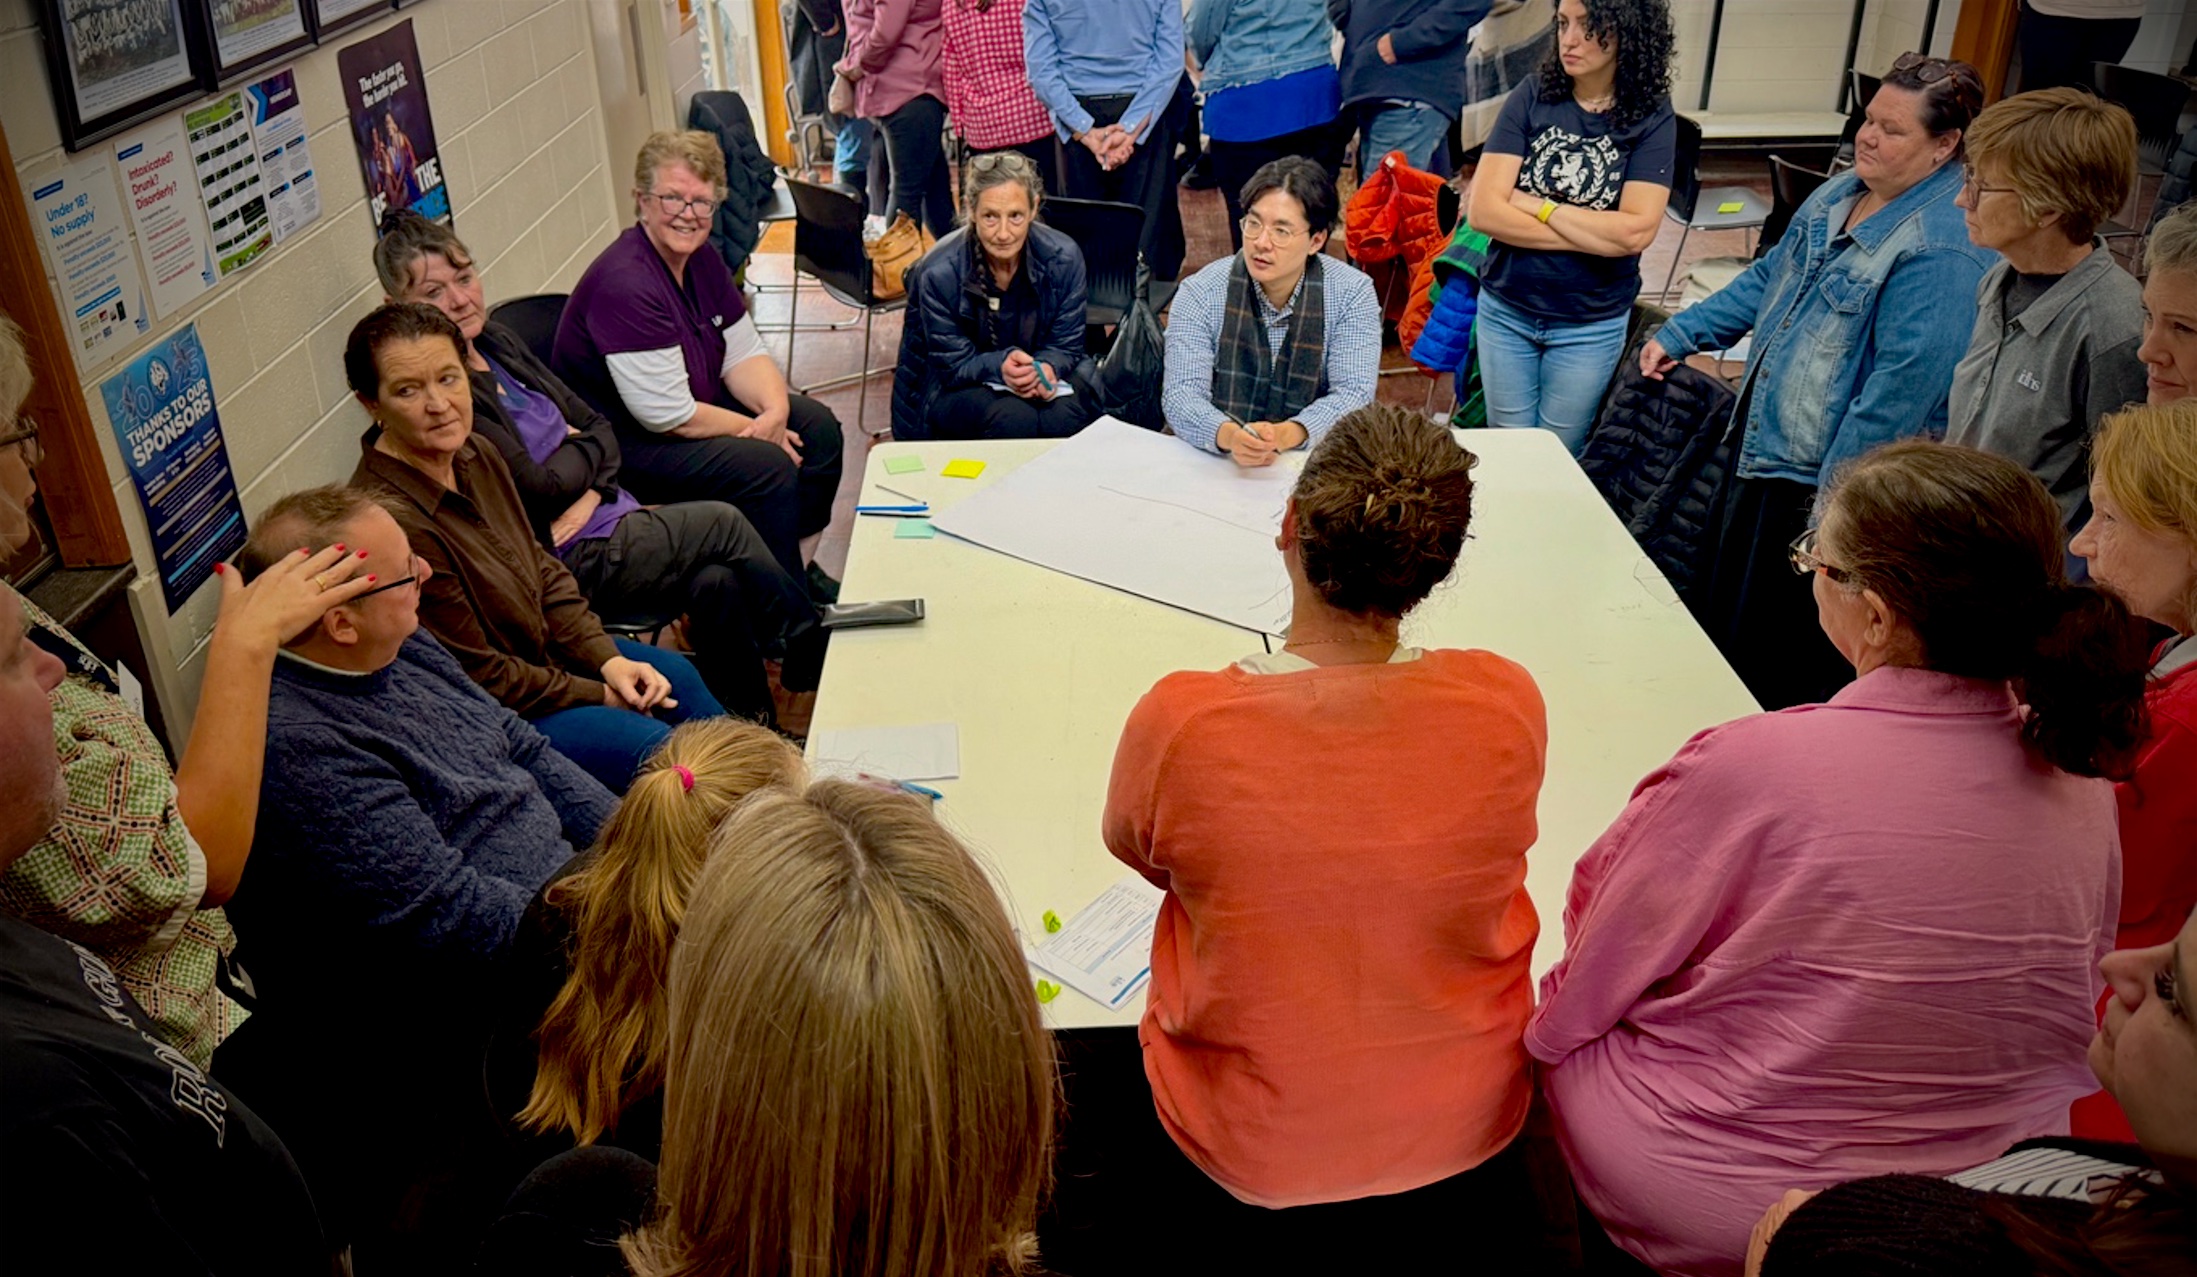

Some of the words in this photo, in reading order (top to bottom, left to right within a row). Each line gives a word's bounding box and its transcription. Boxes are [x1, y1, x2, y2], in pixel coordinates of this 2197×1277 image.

[358, 76, 372, 92] The
[1530, 125, 1619, 166] HILFER
[128, 151, 173, 181] Intoxicated?
[414, 157, 442, 193] THE
[132, 174, 159, 196] Drunk?
[135, 181, 177, 210] Disorderly?
[45, 202, 73, 222] Under
[74, 192, 88, 208] 18?
[51, 223, 66, 239] No
[126, 406, 172, 446] THANKS
[171, 395, 187, 413] TO
[186, 378, 208, 401] OUR
[132, 392, 212, 468] SPONSORS
